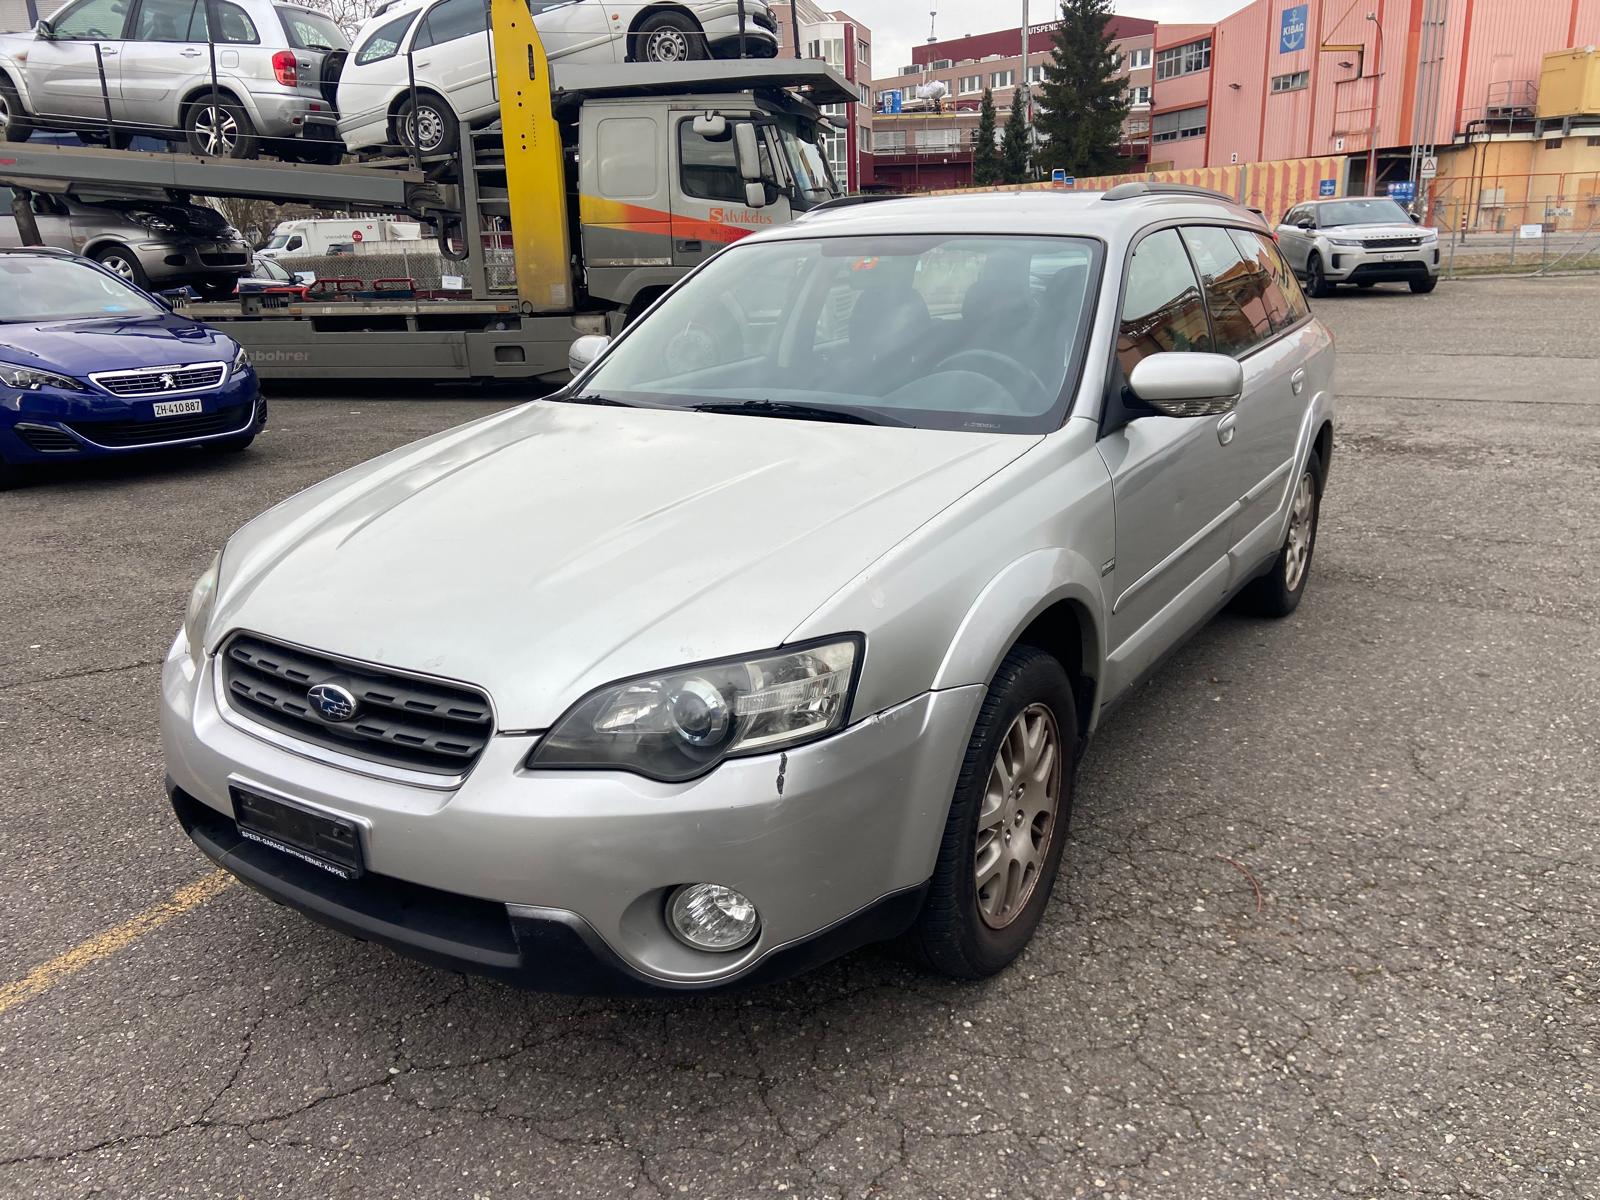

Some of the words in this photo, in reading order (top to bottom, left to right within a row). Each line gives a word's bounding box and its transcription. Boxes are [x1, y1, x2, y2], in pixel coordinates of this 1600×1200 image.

[1021, 21, 1063, 35] UTSPEND
[1283, 22, 1304, 36] KIBAG
[241, 830, 286, 853] SPEER-GARAGE
